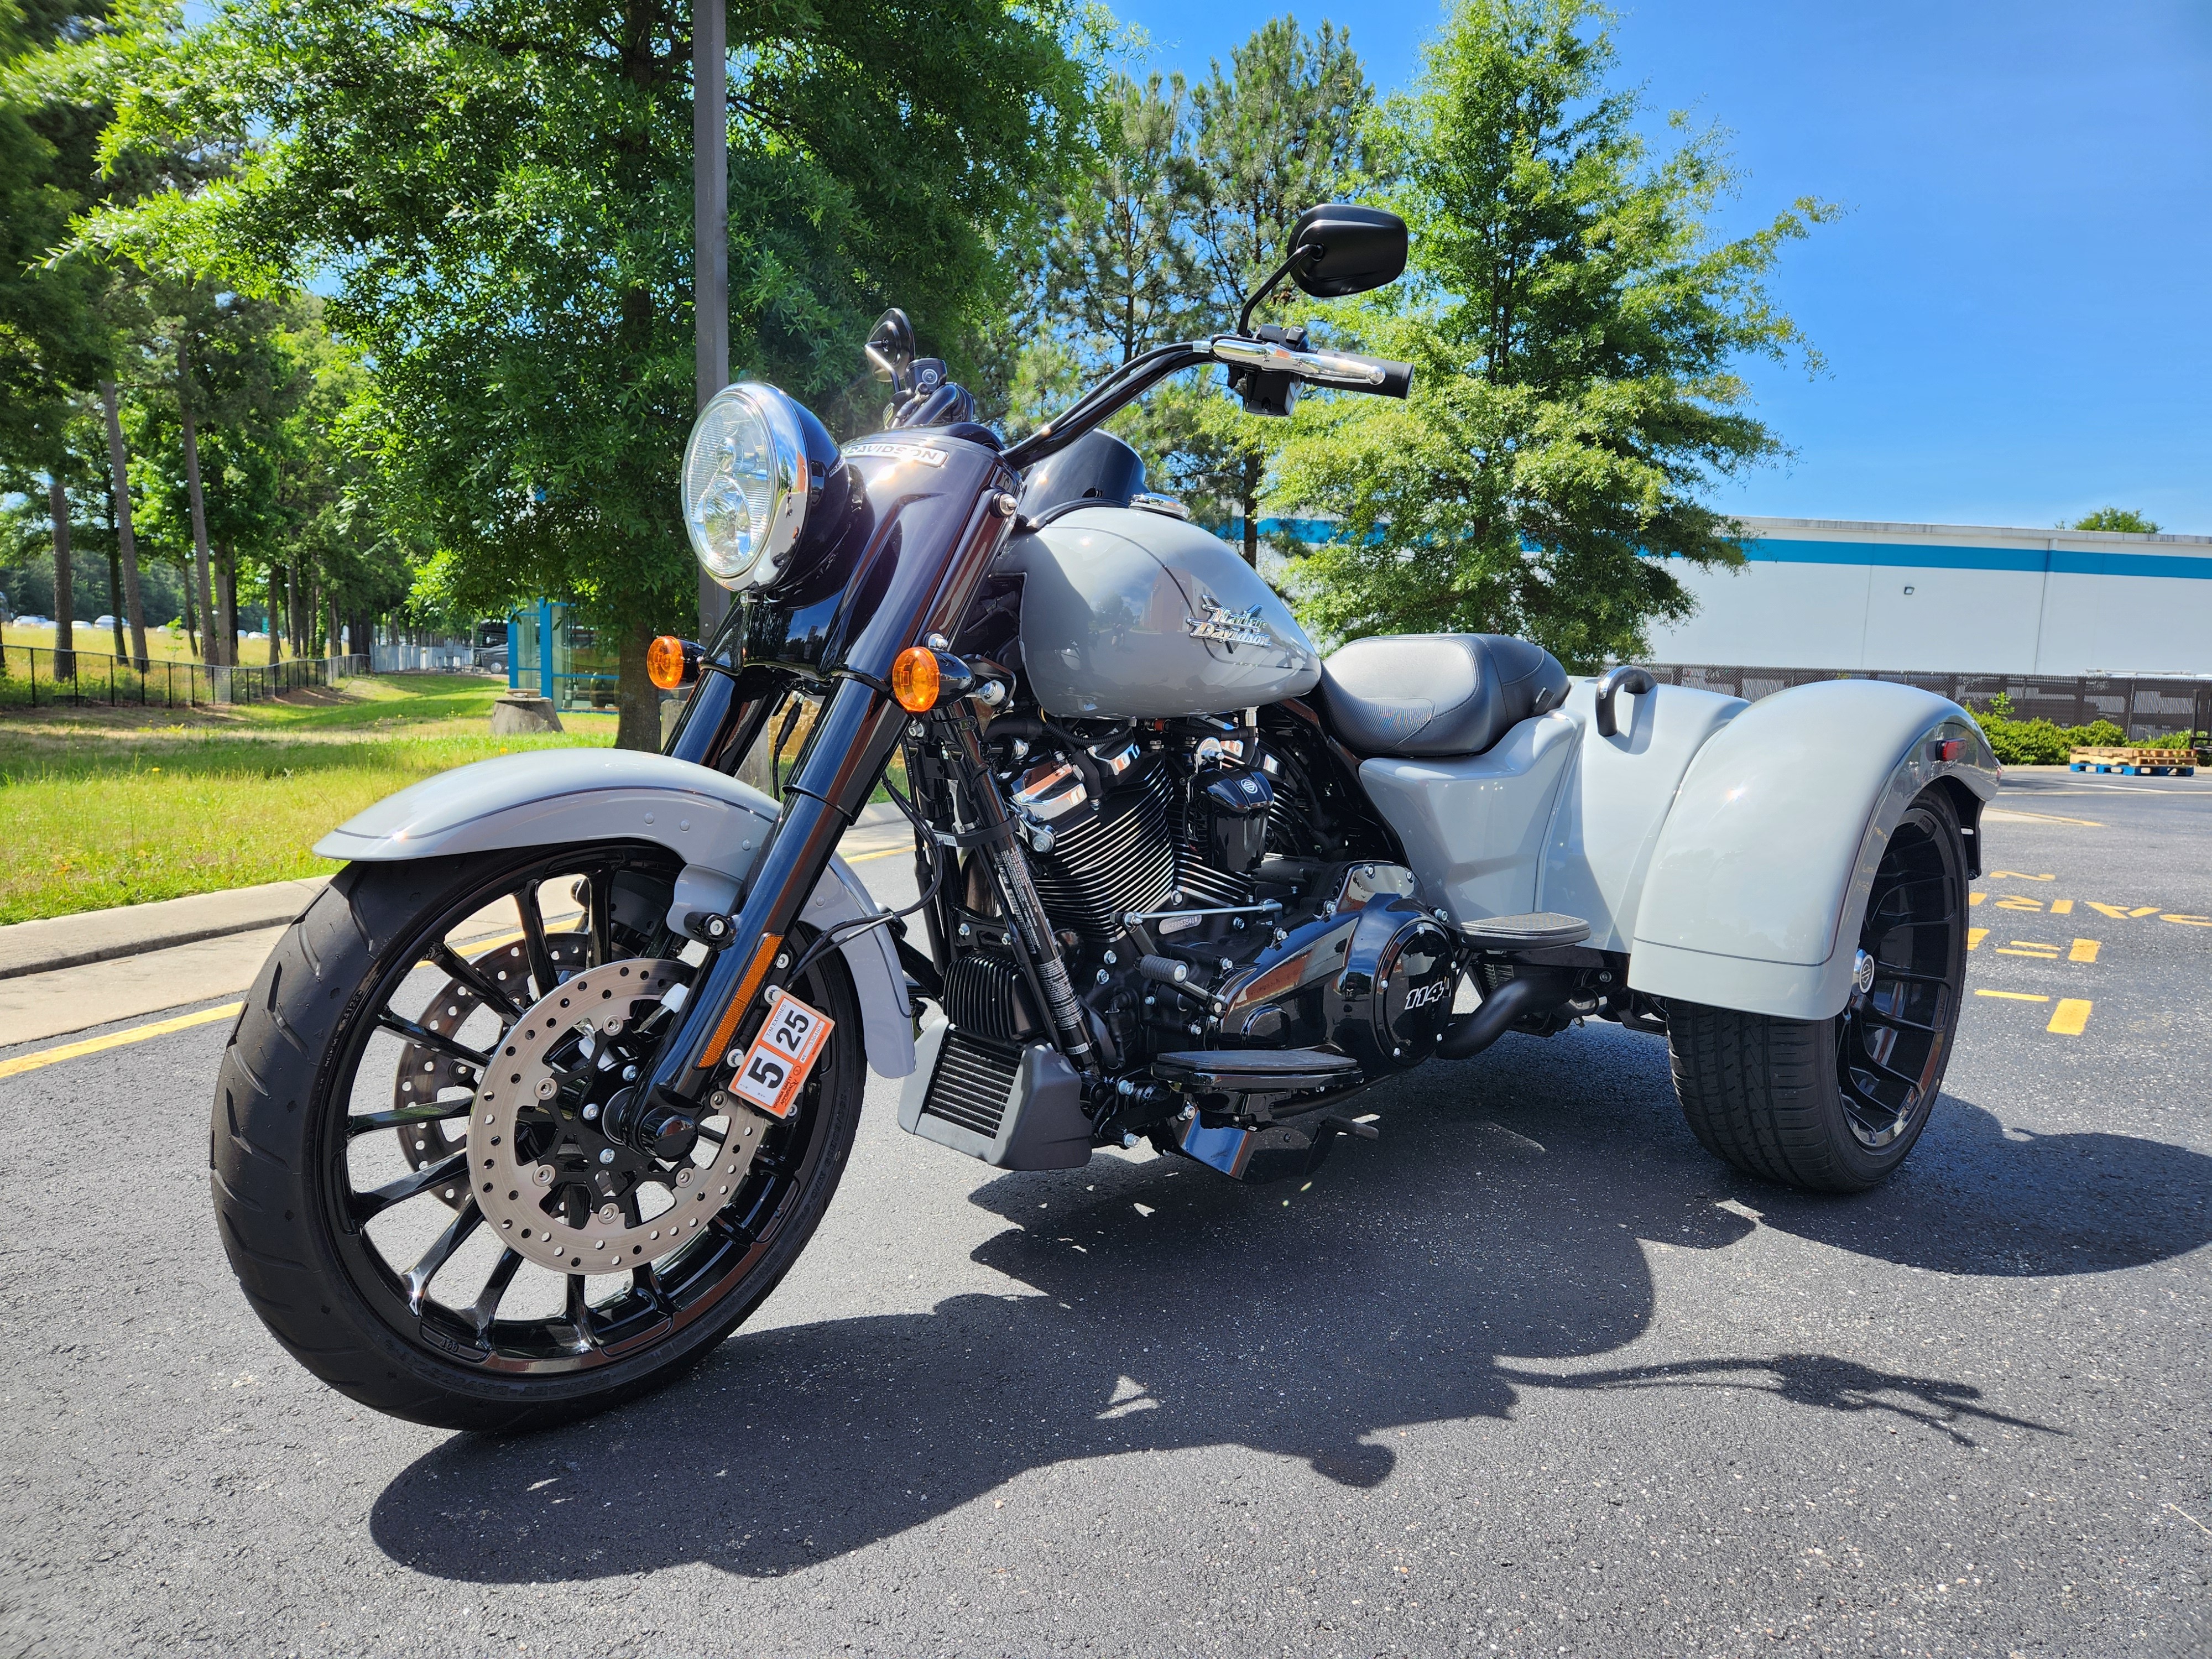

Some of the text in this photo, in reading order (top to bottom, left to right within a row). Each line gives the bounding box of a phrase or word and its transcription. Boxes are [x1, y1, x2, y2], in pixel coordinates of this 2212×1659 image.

[1187, 619, 1271, 647] Davidson
[1404, 980, 1444, 1011] 114
[771, 1004, 786, 1026] EXPIRES
[776, 1009, 808, 1051] 25
[747, 1056, 784, 1087] 5
[773, 1075, 792, 1108] VIRGINIA SAFETY
[780, 1084, 793, 1105] APPROVAL
